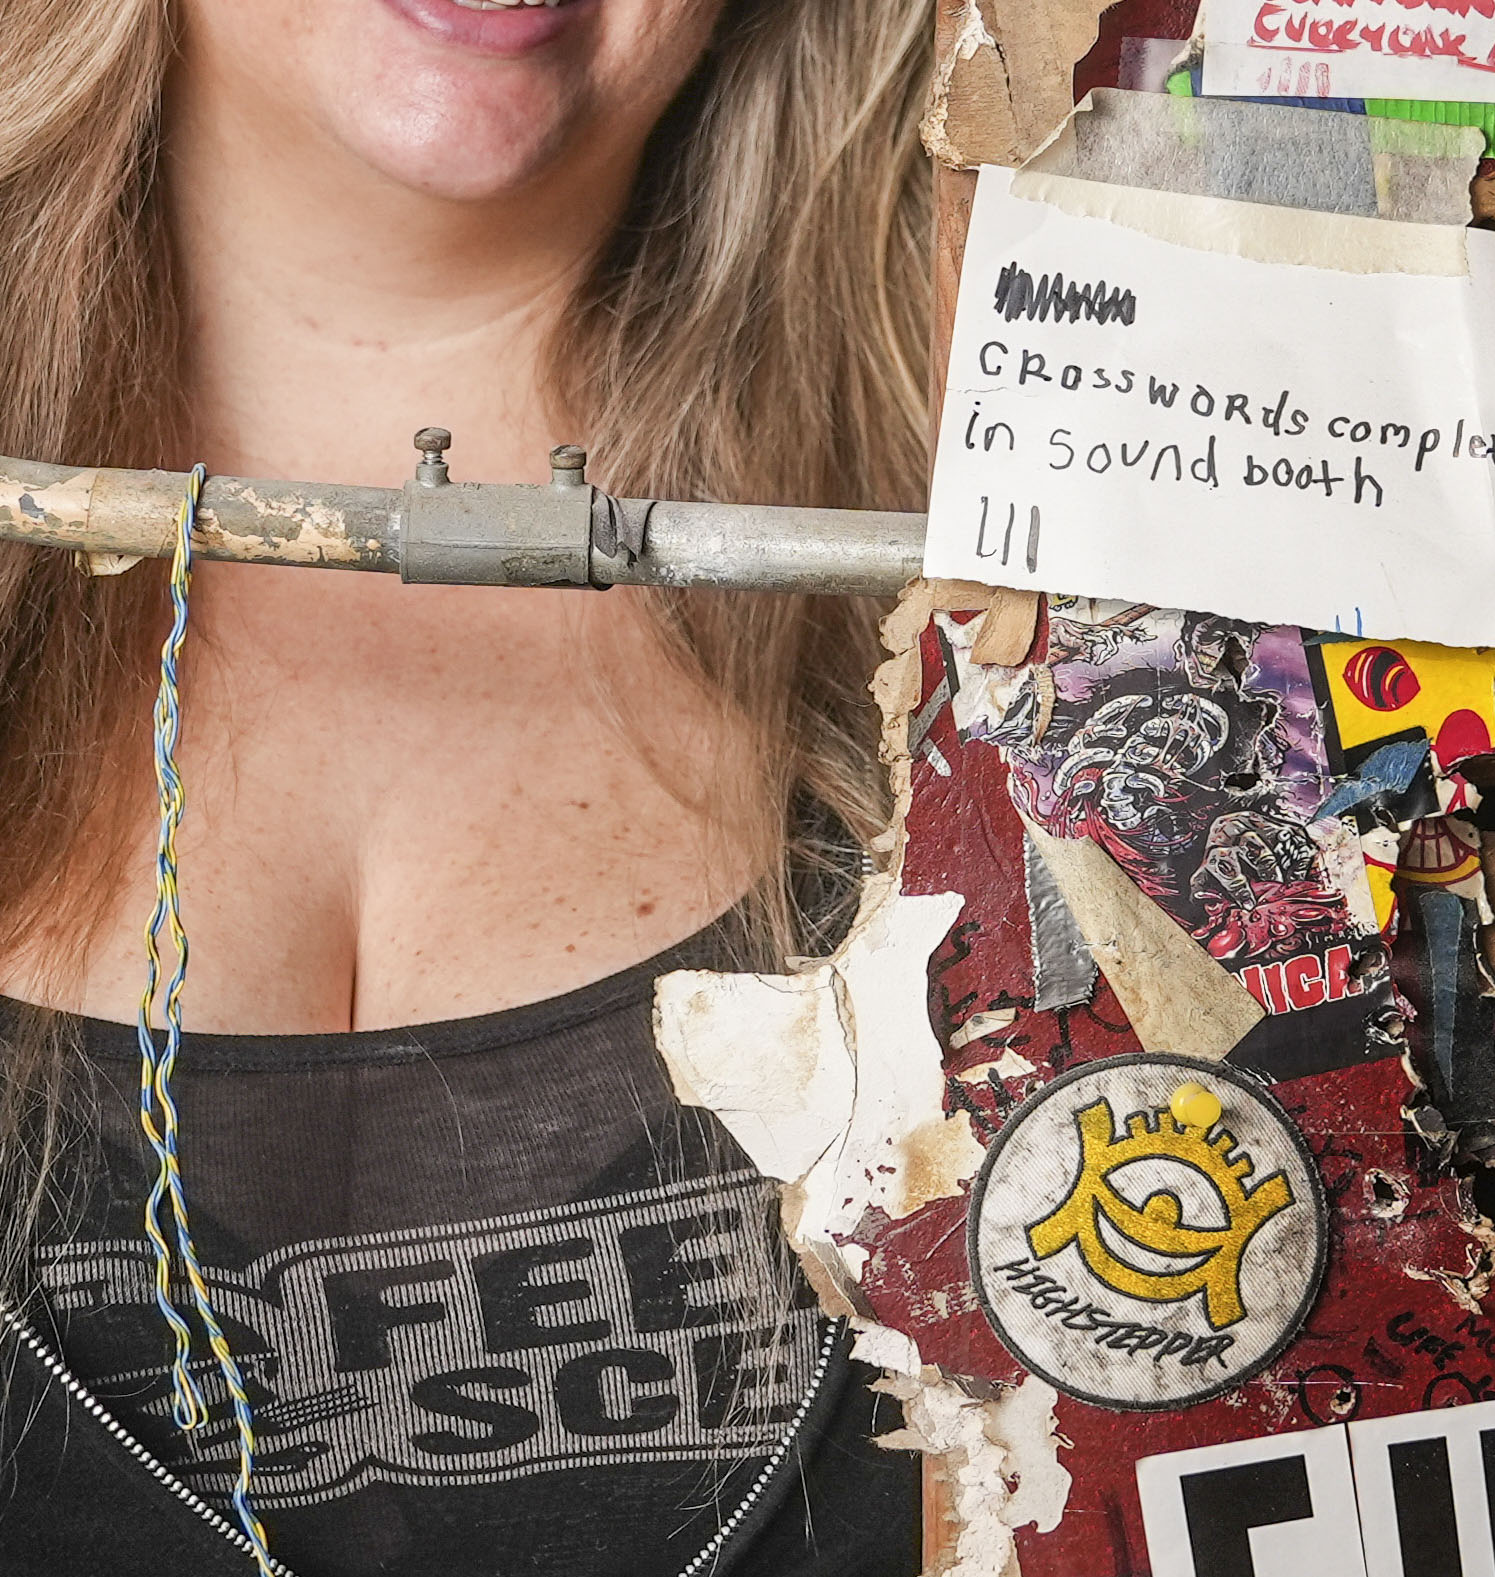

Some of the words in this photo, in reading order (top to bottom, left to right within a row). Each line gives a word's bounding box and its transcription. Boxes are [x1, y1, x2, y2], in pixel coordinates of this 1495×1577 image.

[965, 401, 1016, 453] in
[1244, 453, 1384, 509] booth
[993, 1257, 1237, 1369] HIGHSTEPPER
